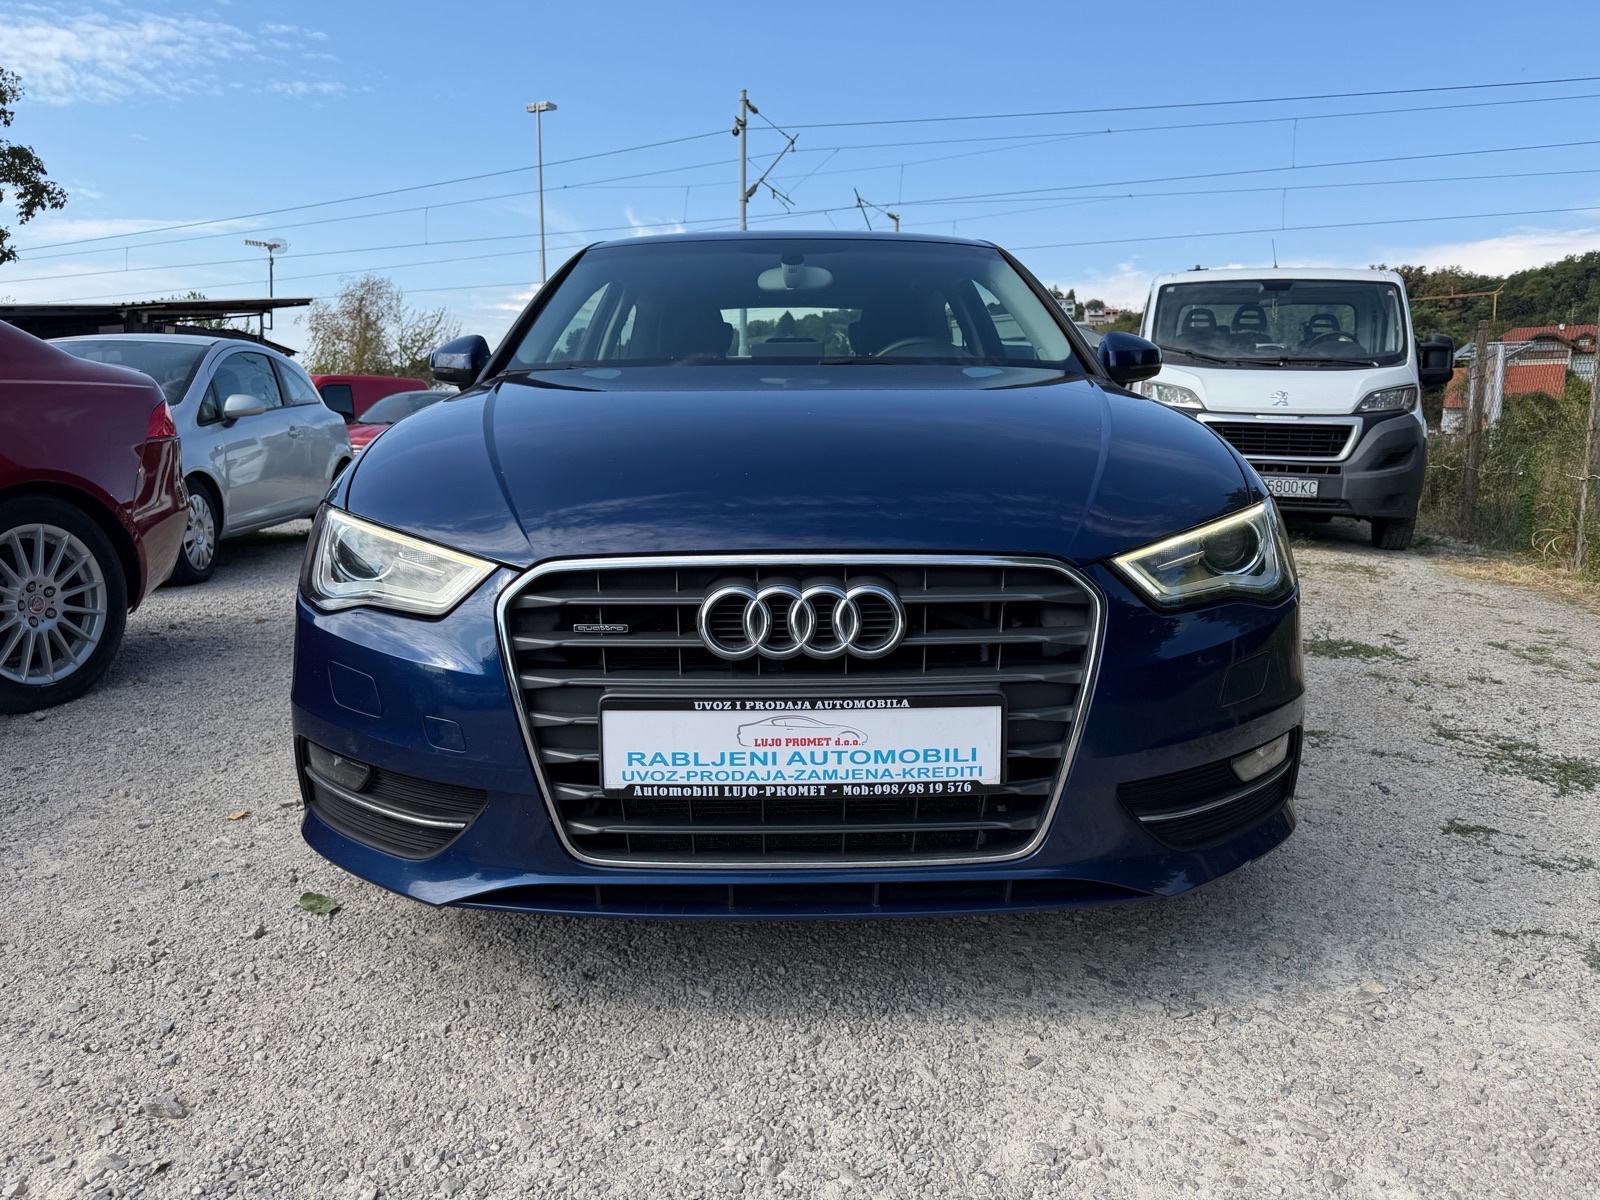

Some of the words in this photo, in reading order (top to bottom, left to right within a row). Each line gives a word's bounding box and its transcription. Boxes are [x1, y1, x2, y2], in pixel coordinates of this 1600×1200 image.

[693, 701, 732, 710] UVOZ
[735, 701, 742, 710] I
[745, 700, 812, 710] PRODAJA
[814, 699, 910, 709] AUTOMOBILA
[754, 738, 782, 747] LUJO
[785, 738, 832, 747] PROMET
[834, 737, 862, 746] d.o.o.
[627, 751, 777, 767] RABLJENI
[786, 747, 977, 766] AUTOMOBILI
[621, 765, 983, 782] UVOZ-PRODAJA-ZAMJENA-KREDITI
[633, 785, 719, 797] Automobili
[723, 785, 827, 798] LUJO-PROMET
[843, 782, 925, 796] Mob:098/98
[928, 782, 943, 794] 19
[947, 781, 972, 793] 576
